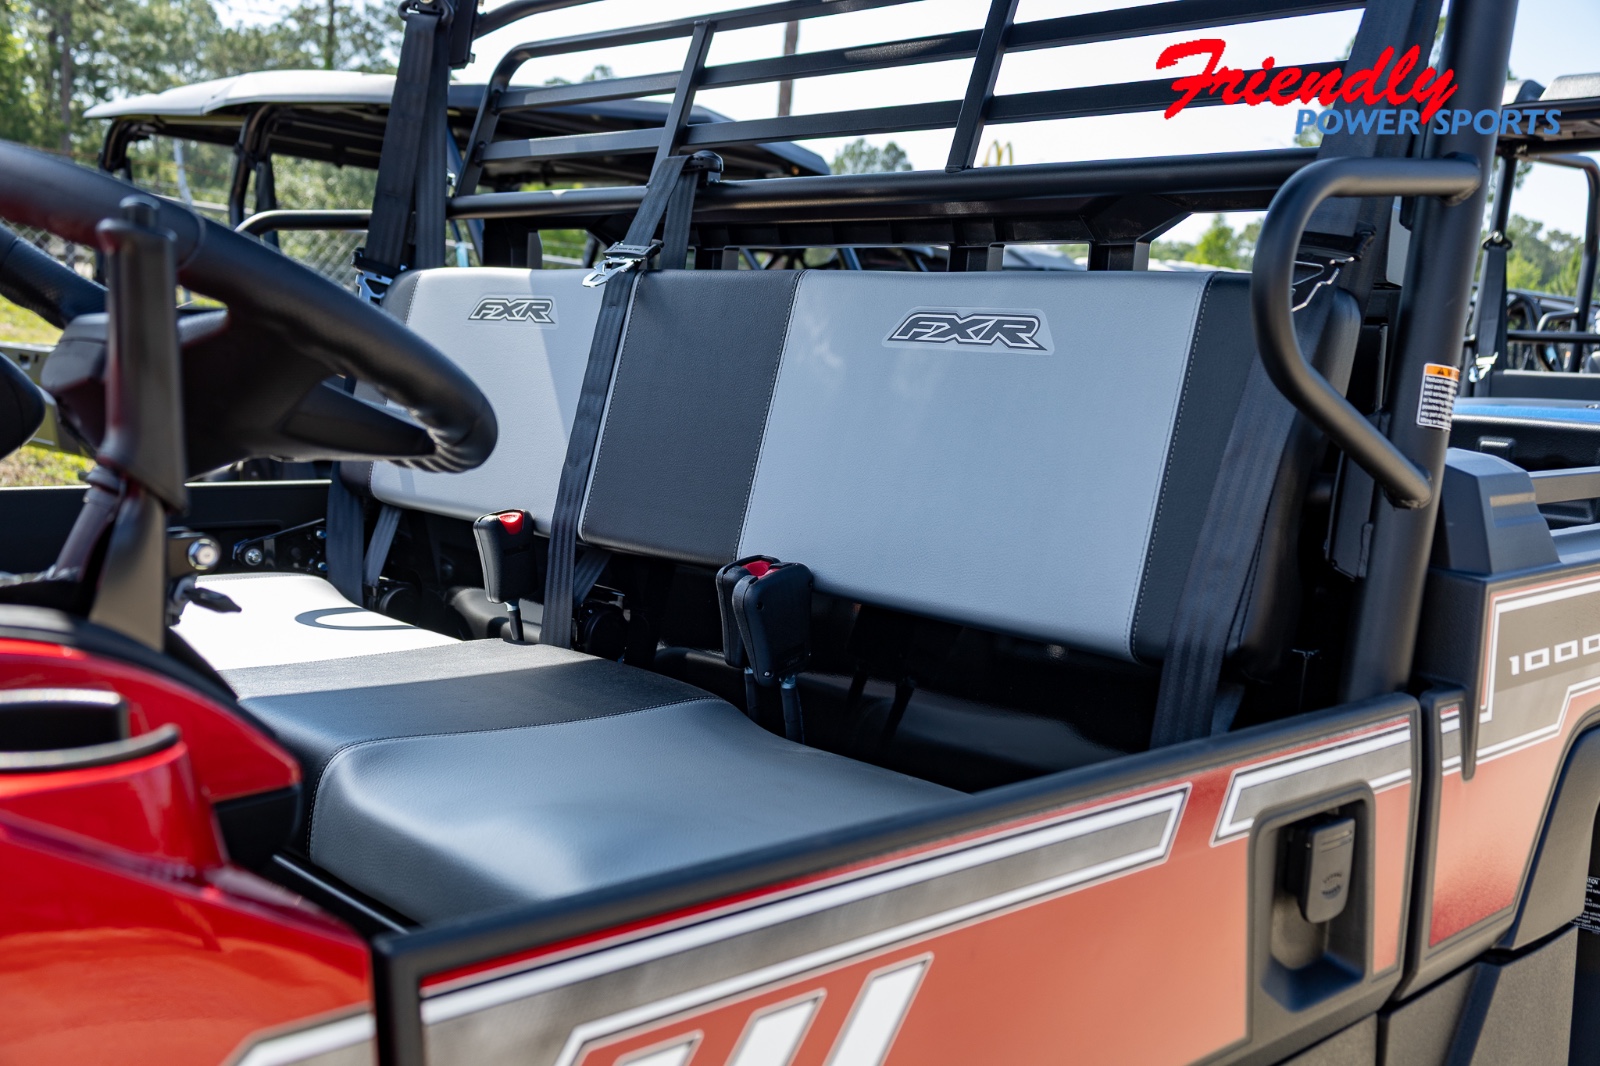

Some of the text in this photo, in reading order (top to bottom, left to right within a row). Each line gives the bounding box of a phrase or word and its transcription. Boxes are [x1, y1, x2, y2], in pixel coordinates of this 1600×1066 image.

[468, 298, 556, 324] FXR
[887, 311, 1048, 351] FXR
[1508, 633, 1600, 675] 1000
